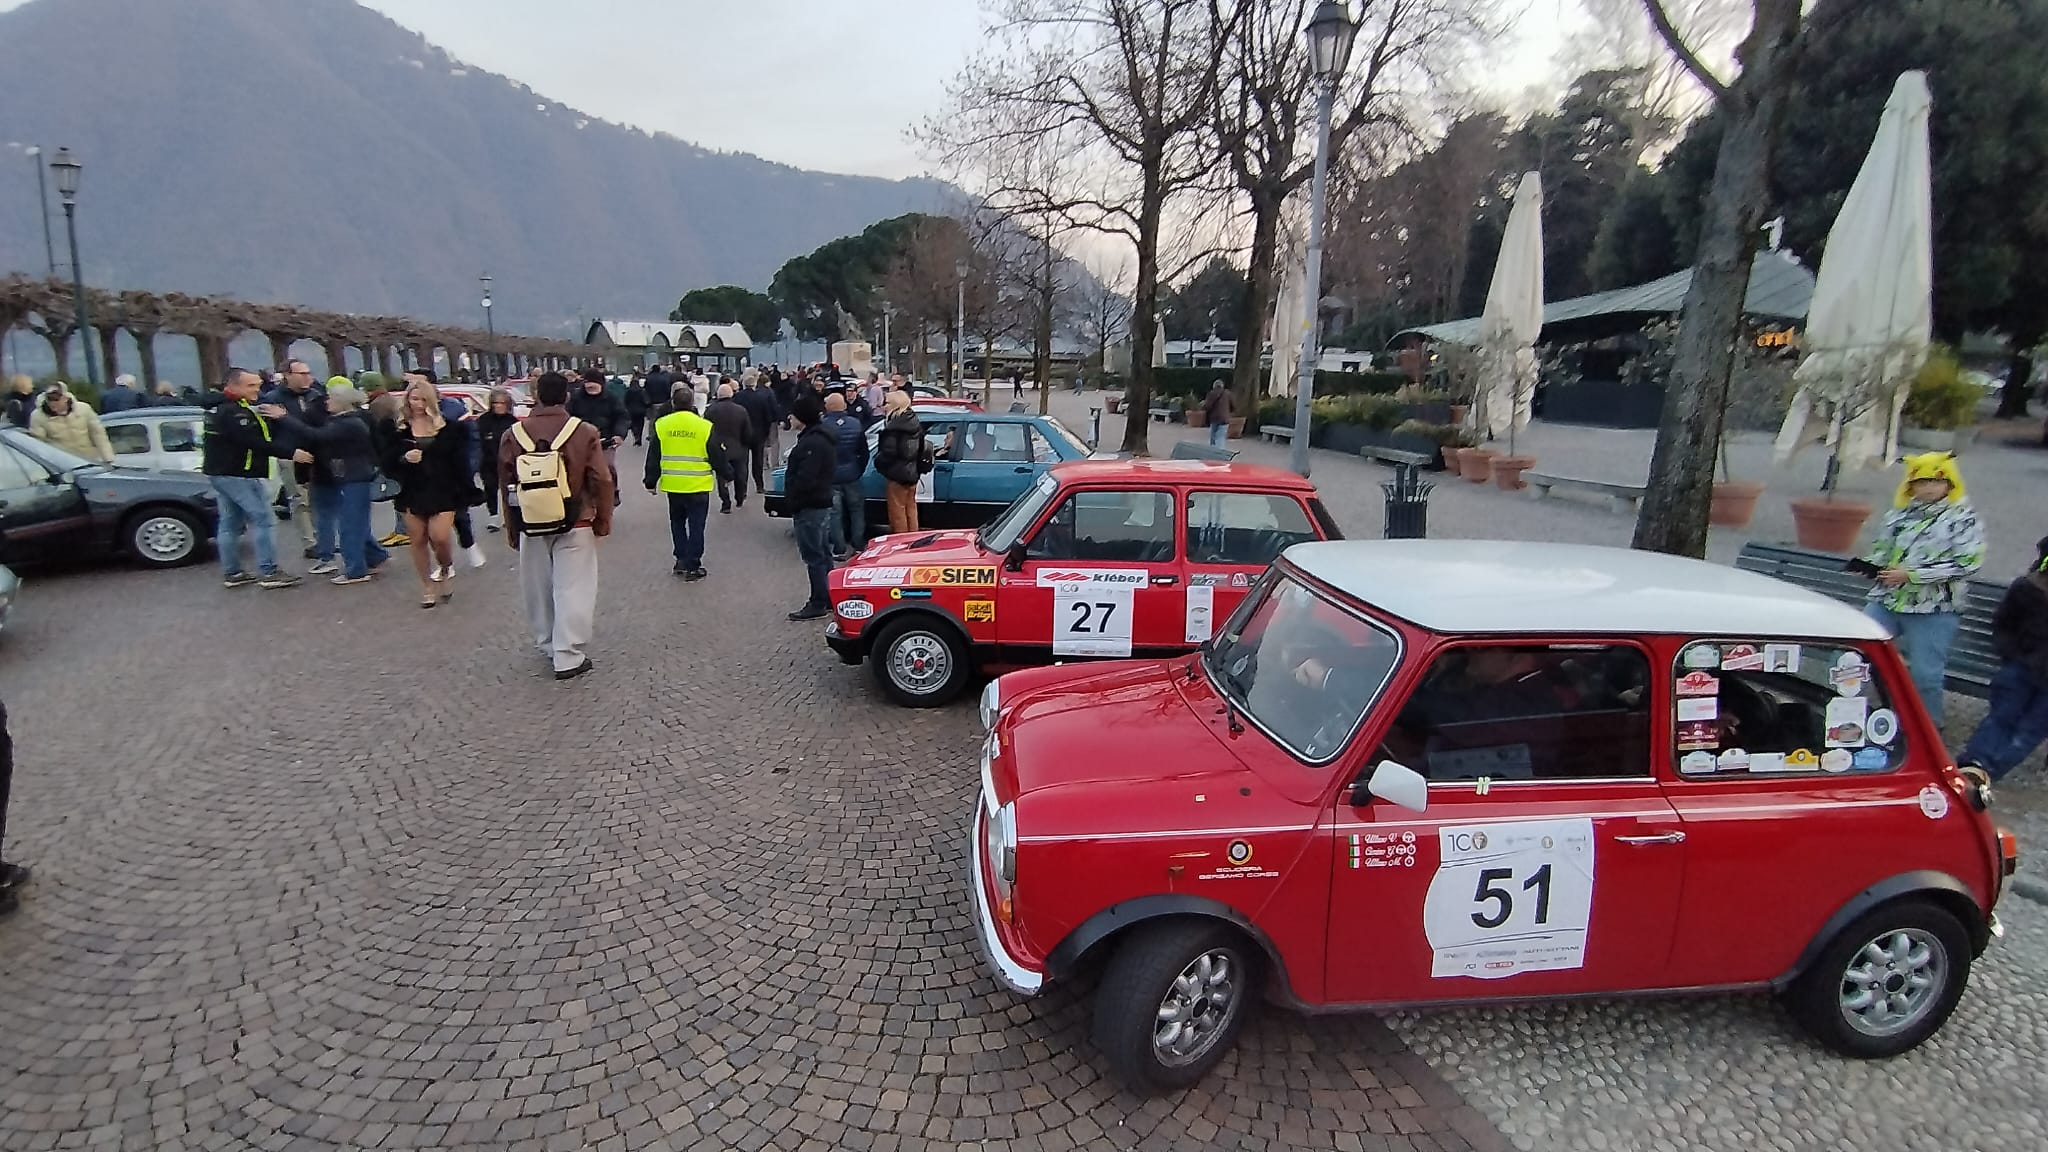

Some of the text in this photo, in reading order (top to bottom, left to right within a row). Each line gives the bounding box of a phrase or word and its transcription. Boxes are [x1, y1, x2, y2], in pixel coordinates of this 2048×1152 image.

[941, 568, 995, 584] SIEM
[1092, 573, 1144, 583] kléber
[1070, 602, 1116, 633] 27
[1471, 864, 1551, 928] 51
